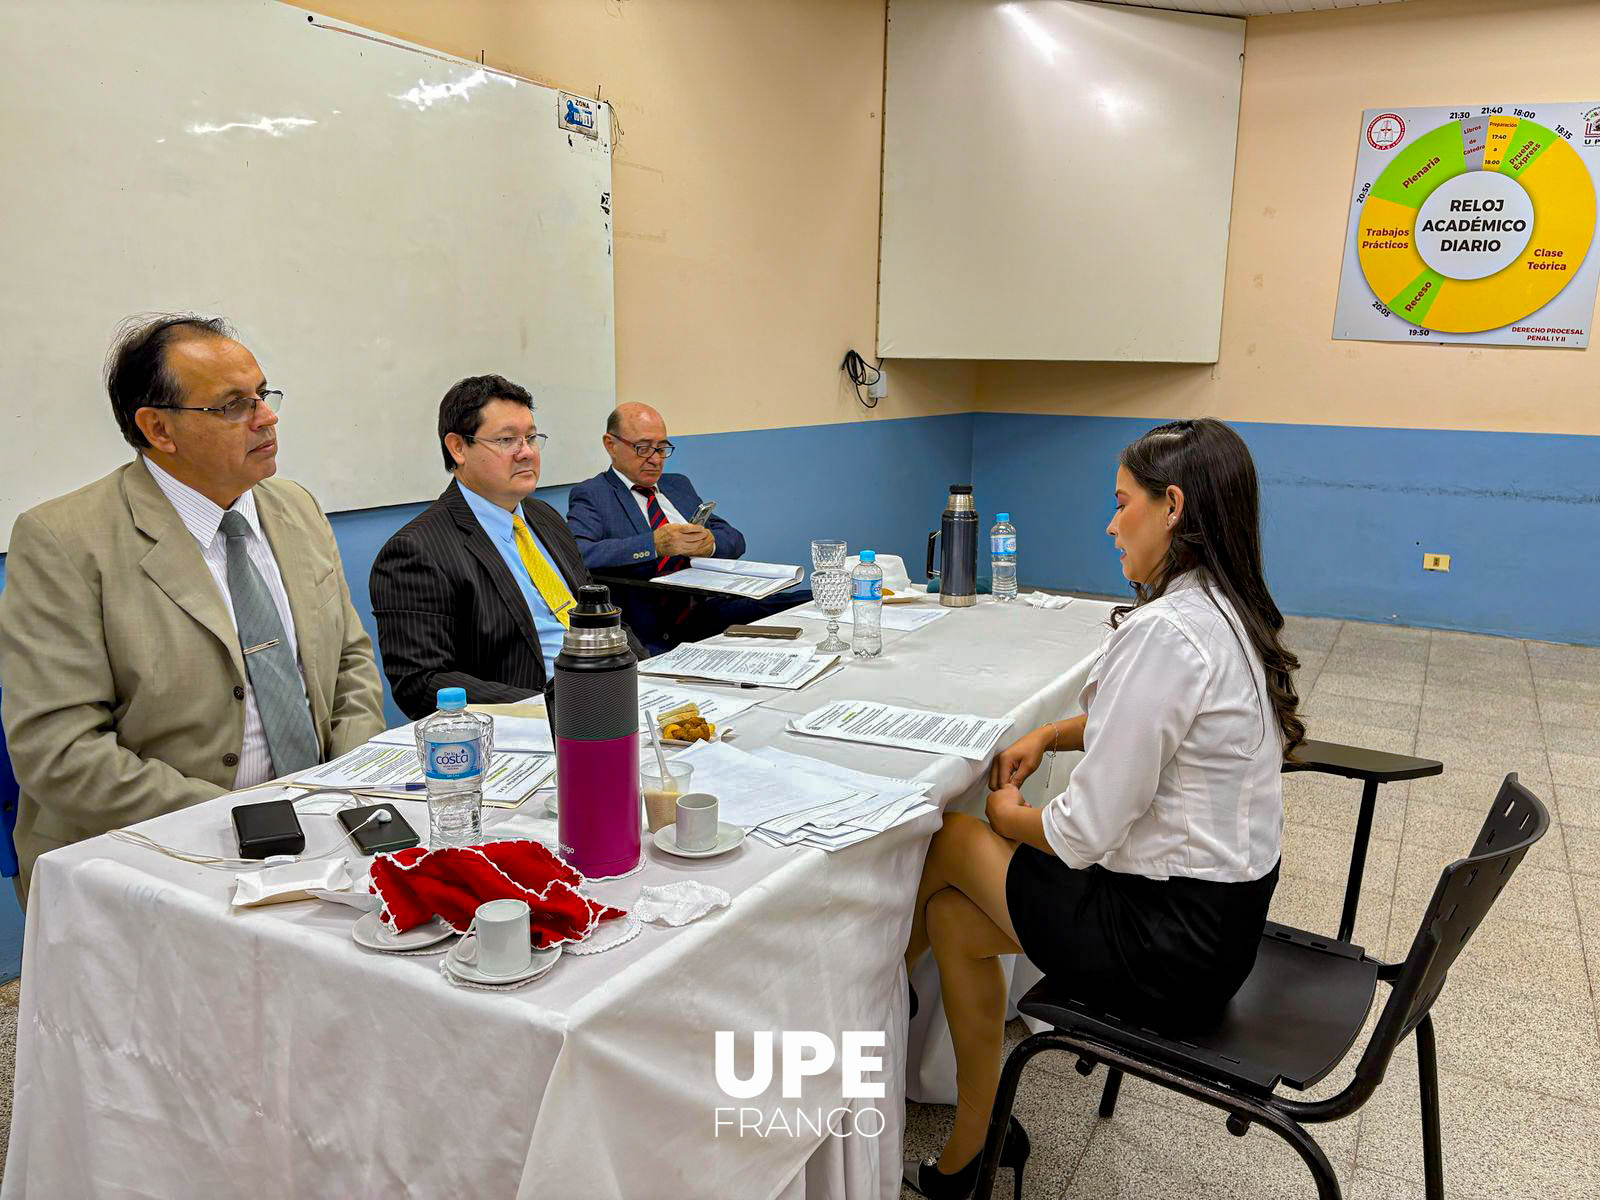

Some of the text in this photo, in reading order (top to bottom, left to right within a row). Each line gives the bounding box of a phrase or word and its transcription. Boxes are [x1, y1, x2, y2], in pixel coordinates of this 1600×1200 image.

[575, 99, 590, 109] ZONA
[1449, 111, 1471, 119] 21:30
[1481, 106, 1503, 114] 21:40
[1513, 108, 1536, 119] 18:00
[1463, 125, 1482, 134] Libros
[1554, 124, 1573, 140] 18:15
[1509, 140, 1534, 165] Prueba
[1513, 143, 1541, 171] Express
[1402, 156, 1441, 189] Plenaria
[1356, 182, 1372, 204] 20:50
[1449, 199, 1505, 212] RELOJ
[1421, 216, 1527, 232] ACADÉMICO
[1366, 228, 1410, 238] Trabajos
[1362, 240, 1409, 249] Prácticos
[1440, 239, 1501, 252] DIARIO
[1534, 248, 1564, 257] Clase
[1528, 261, 1567, 271] Teórica
[1405, 281, 1432, 312] Receso
[1372, 301, 1391, 317] 20:05
[1409, 329, 1430, 337] 19:50
[1511, 326, 1546, 334] DERECHO
[436, 754, 469, 765] costa
